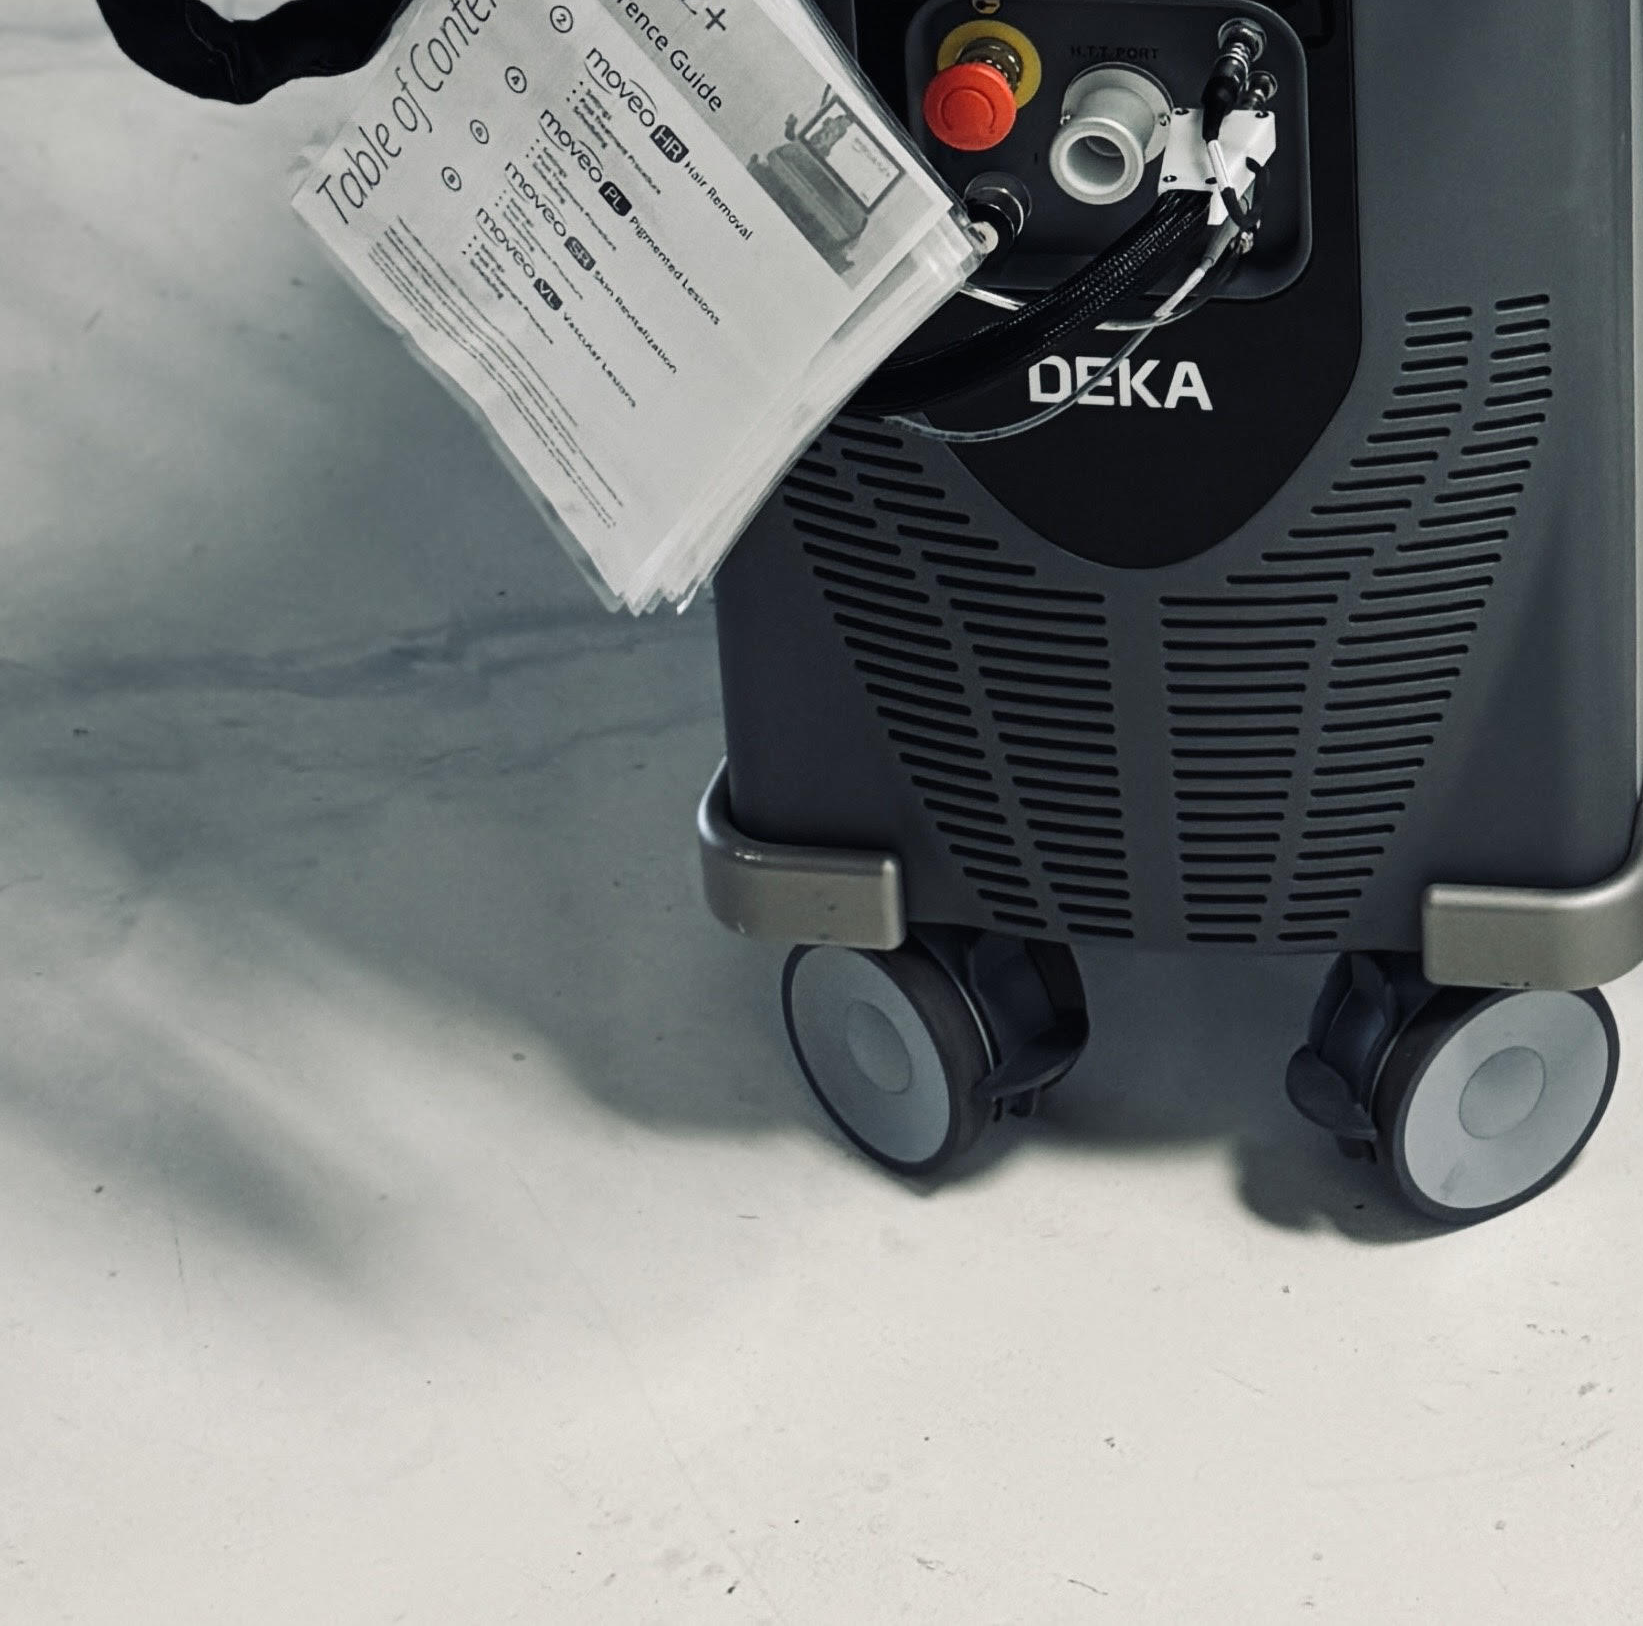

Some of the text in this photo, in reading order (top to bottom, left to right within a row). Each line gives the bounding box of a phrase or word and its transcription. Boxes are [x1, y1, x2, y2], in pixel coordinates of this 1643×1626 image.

[668, 49, 722, 113] Guide
[314, 122, 402, 226] Table
[391, 64, 433, 133] of
[584, 46, 655, 128] moveo
[654, 125, 685, 163] HR
[682, 159, 708, 187] Hair
[705, 186, 753, 240] Removal
[503, 160, 566, 237] moveo
[539, 107, 603, 183] moveo
[628, 215, 684, 280] Pigmented
[681, 277, 720, 325] Lesions
[475, 206, 536, 279] moveo
[1028, 355, 1213, 411] DEKA
